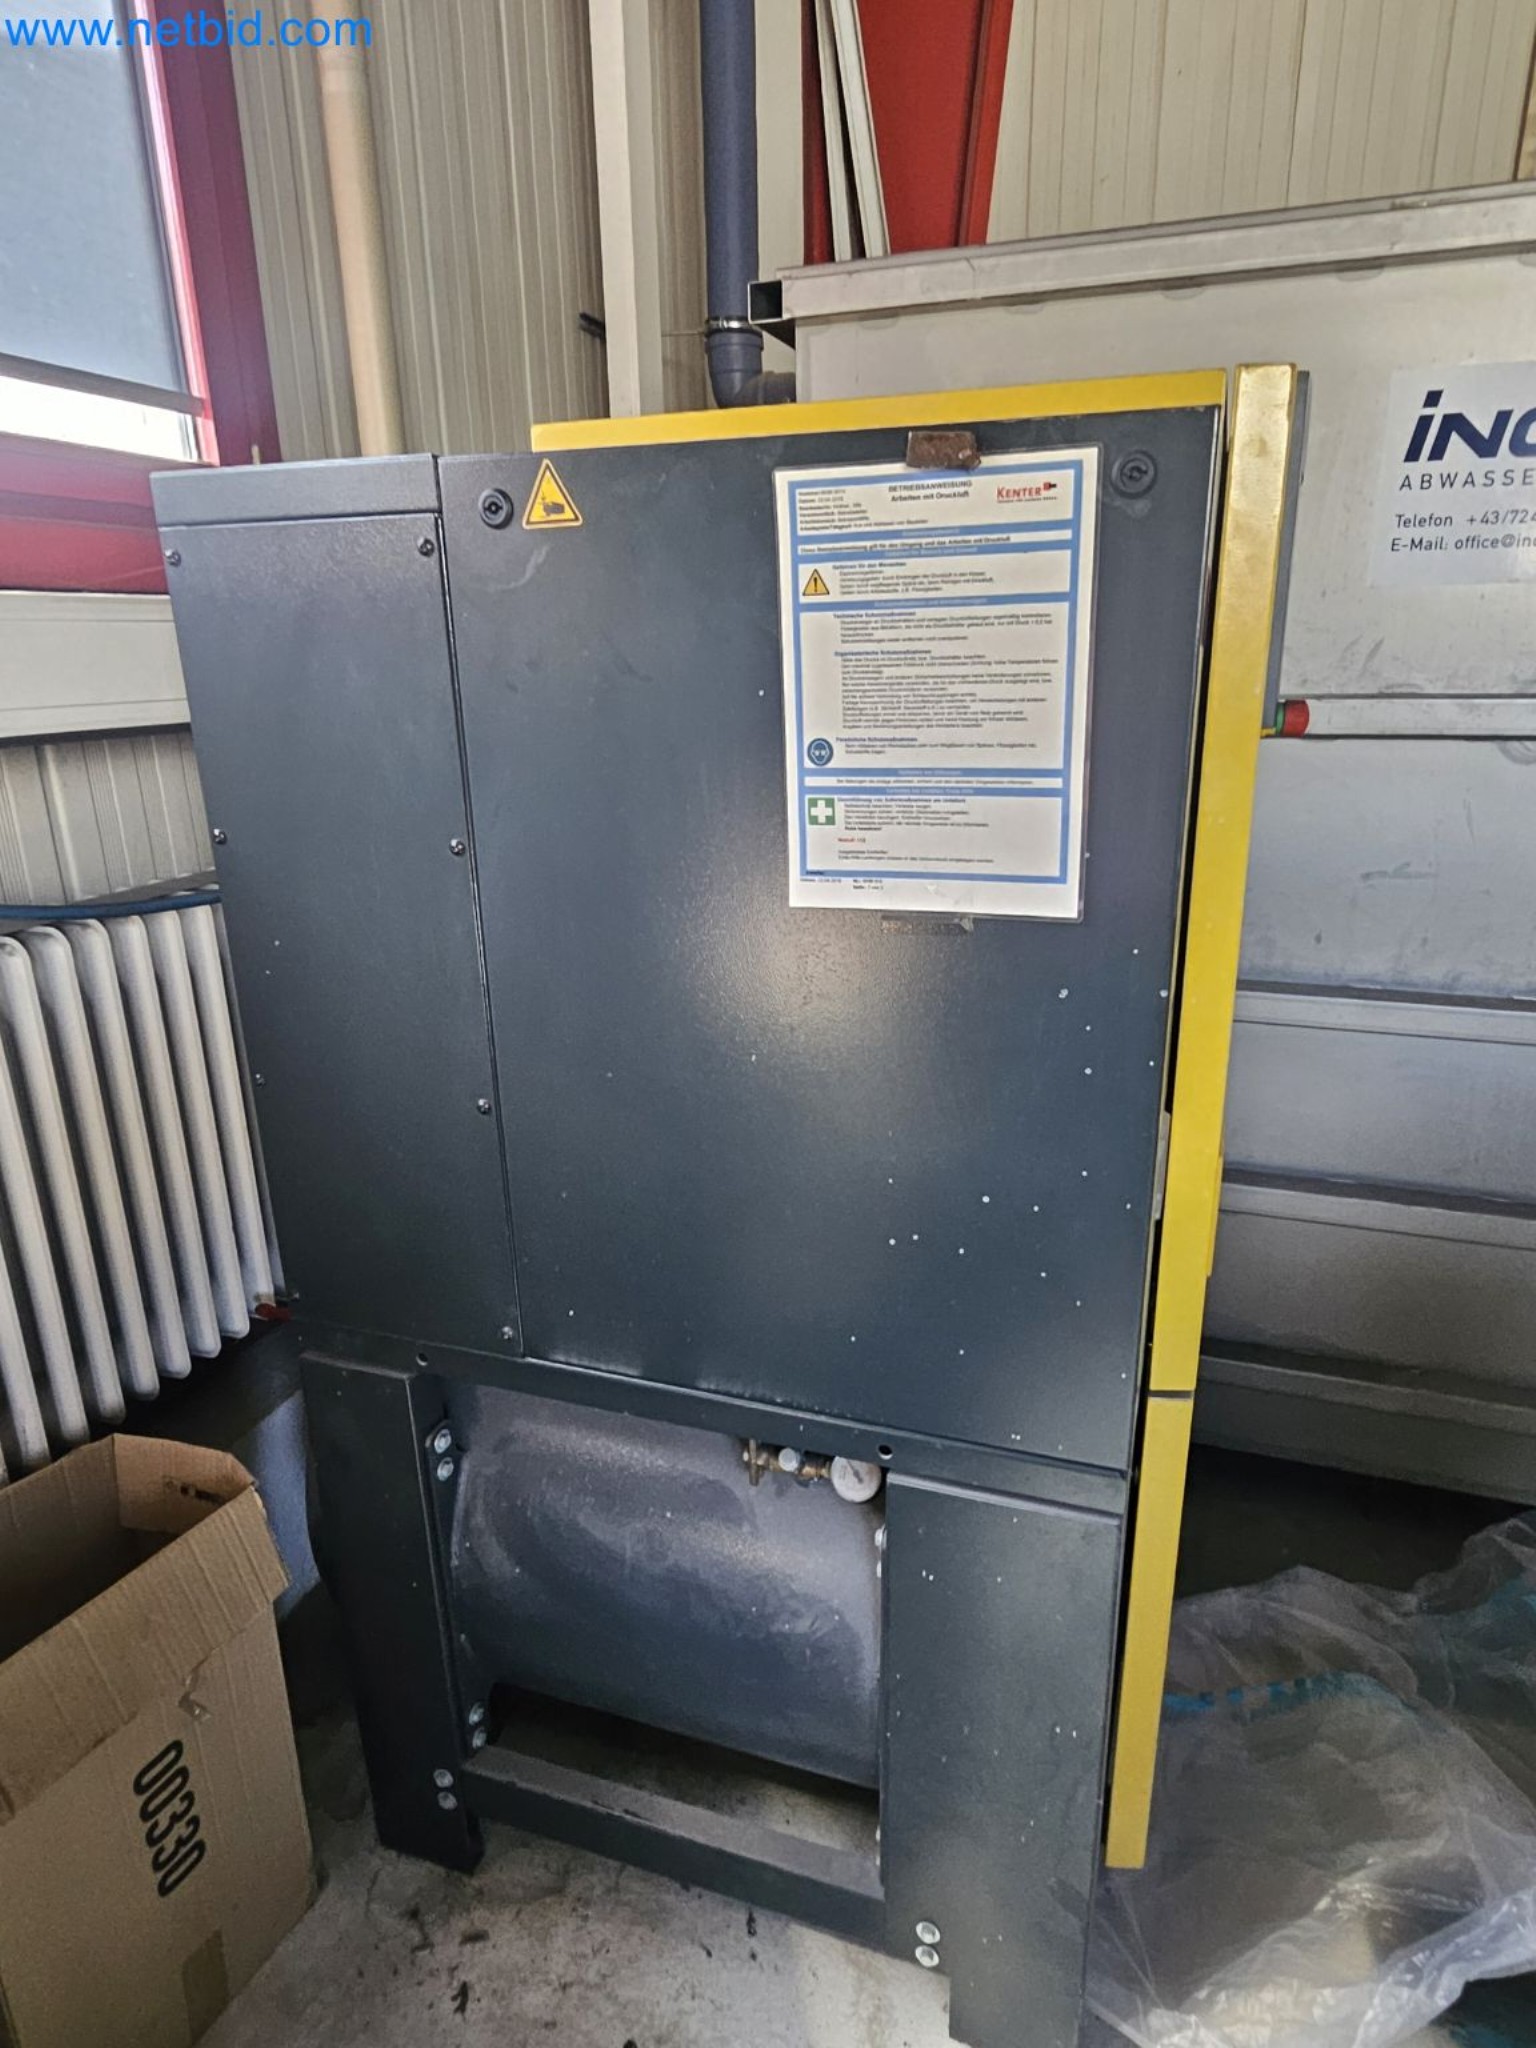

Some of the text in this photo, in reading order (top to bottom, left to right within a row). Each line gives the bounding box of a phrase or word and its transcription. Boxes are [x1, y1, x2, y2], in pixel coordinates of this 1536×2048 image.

[1399, 468, 1536, 492] ABWASSE
[1395, 512, 1453, 529] Telefon
[133, 1740, 206, 1897] 00330
